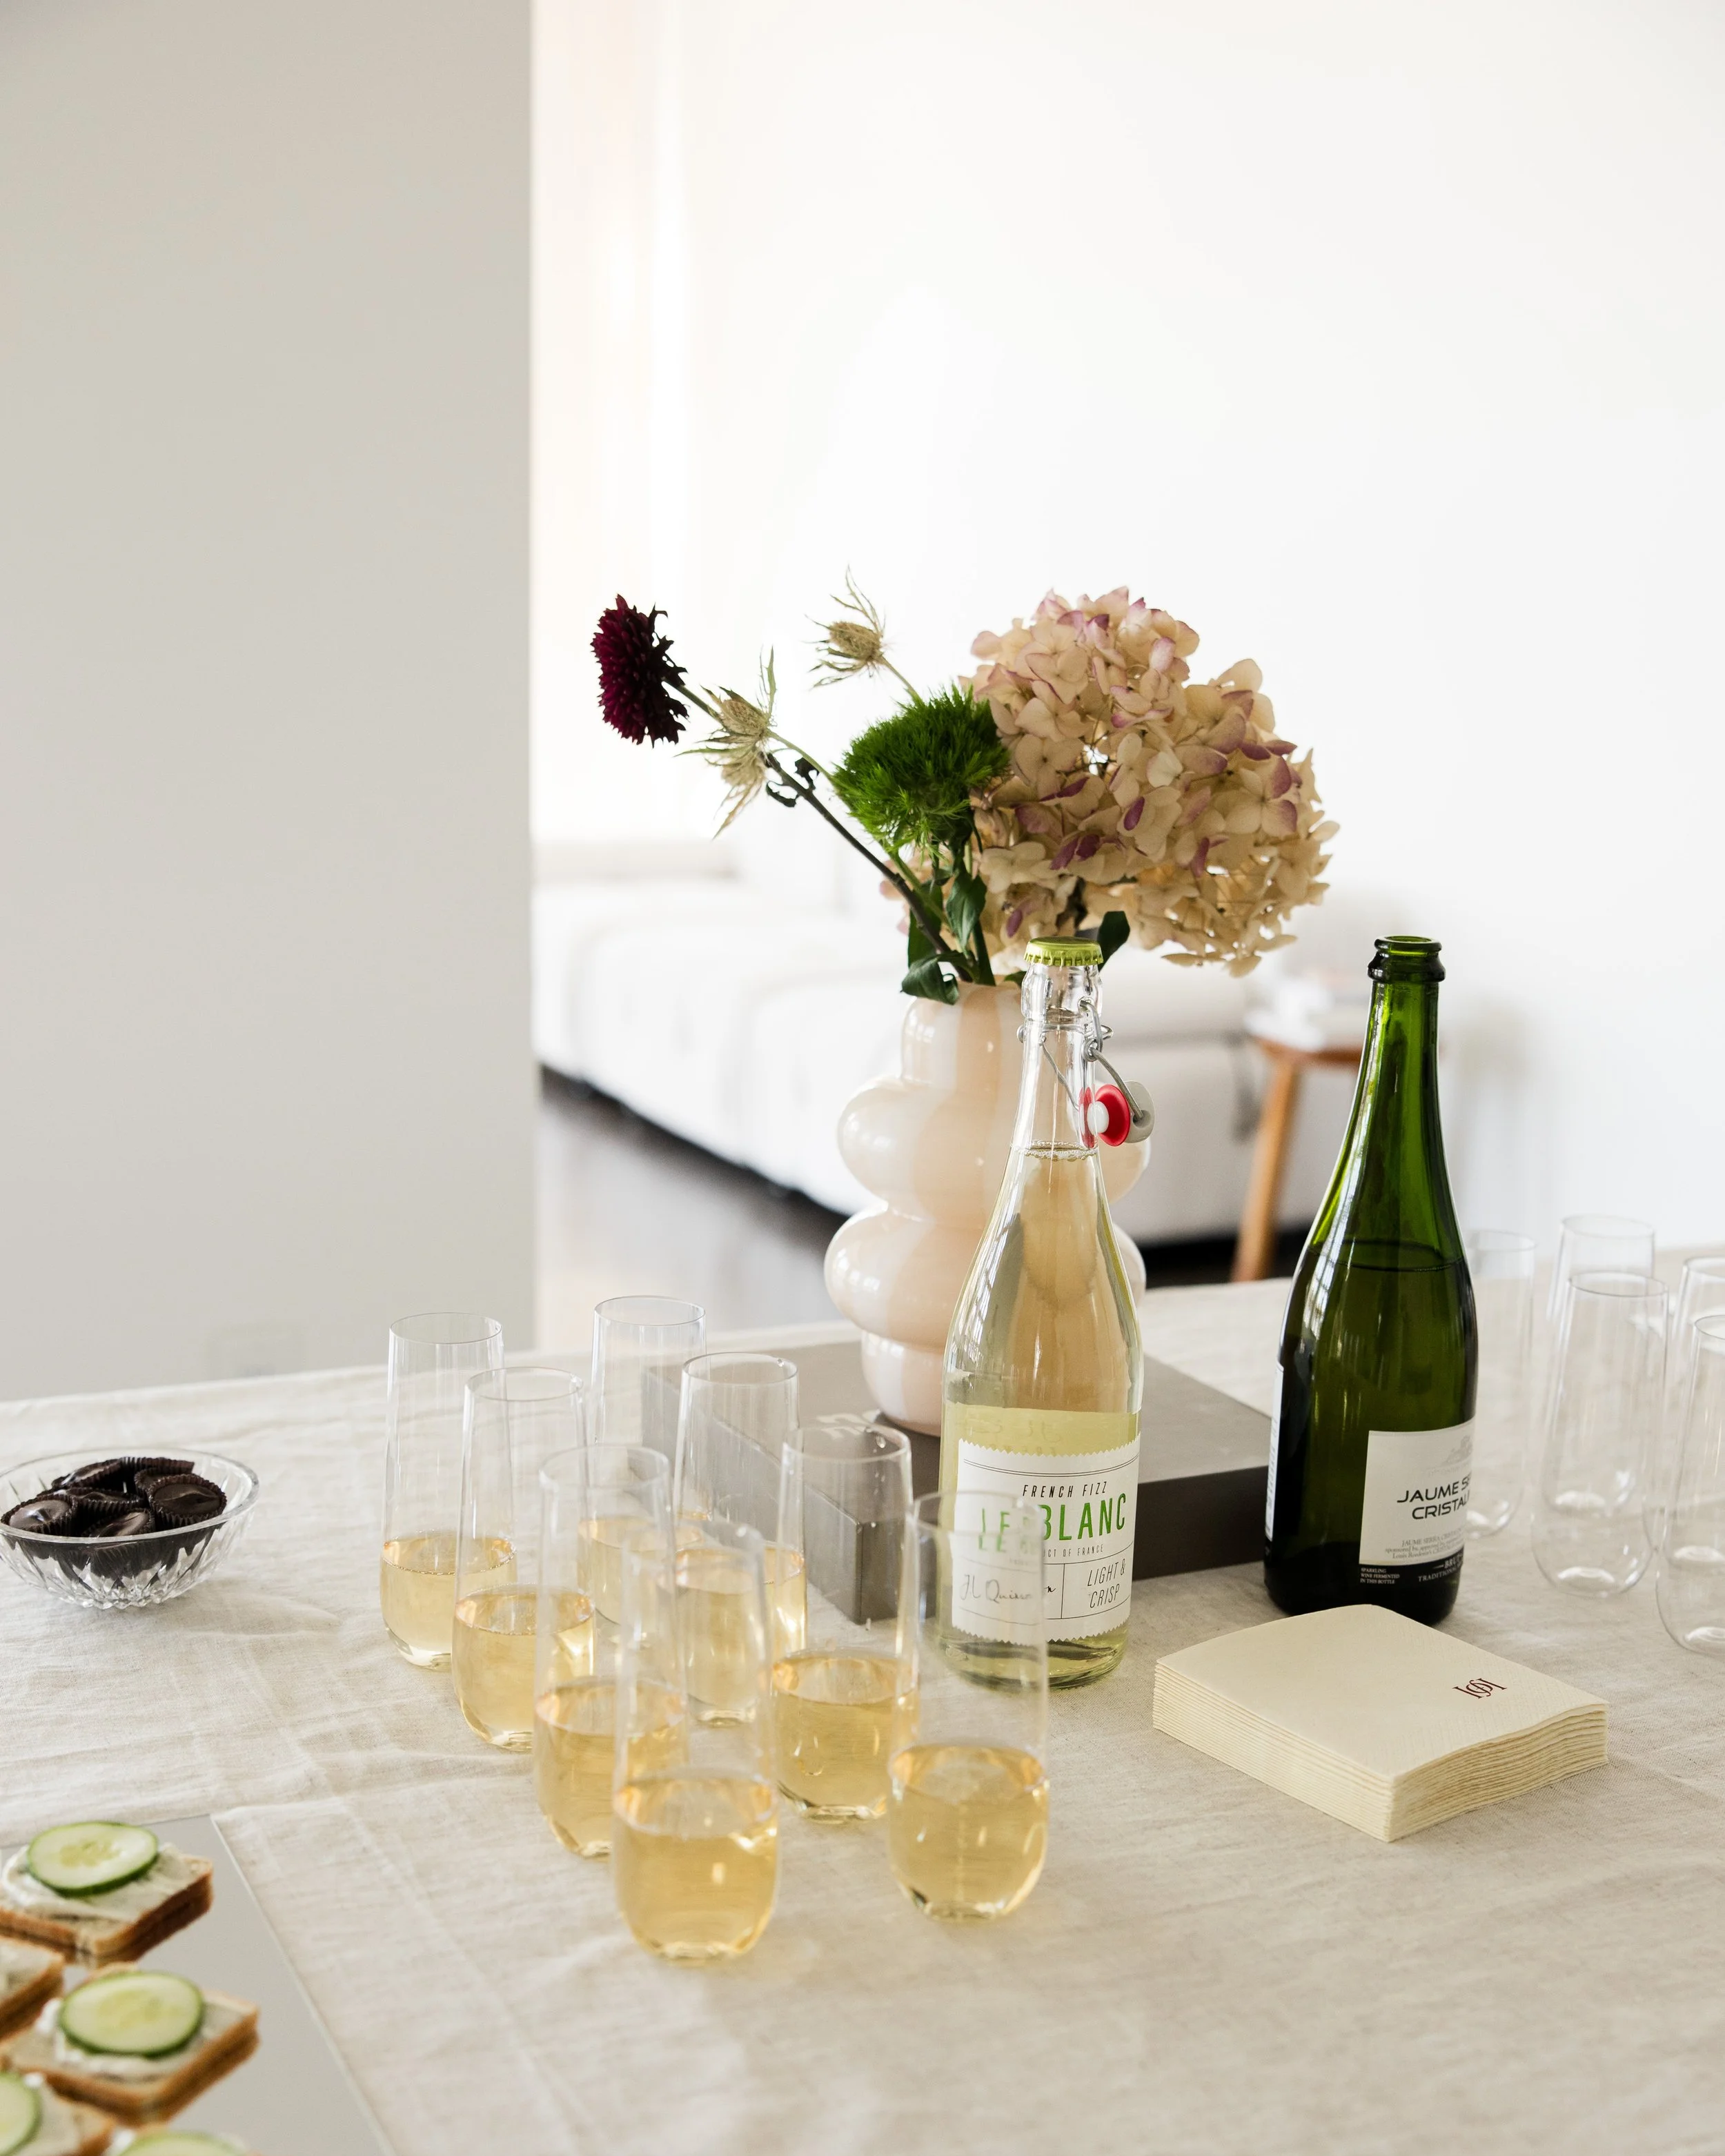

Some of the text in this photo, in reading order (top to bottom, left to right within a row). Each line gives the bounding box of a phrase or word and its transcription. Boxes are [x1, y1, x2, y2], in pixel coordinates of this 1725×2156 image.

[1023, 1481, 1107, 1498] FRENCH FIZZ
[1397, 1481, 1459, 1503] JAUME
[1037, 1493, 1126, 1541] BLANC
[1063, 1548, 1072, 1557] OF
[1077, 1543, 1103, 1556] FRANCE
[1087, 1558, 1125, 1586] LIGHT &
[1090, 1583, 1120, 1608] CRISP
